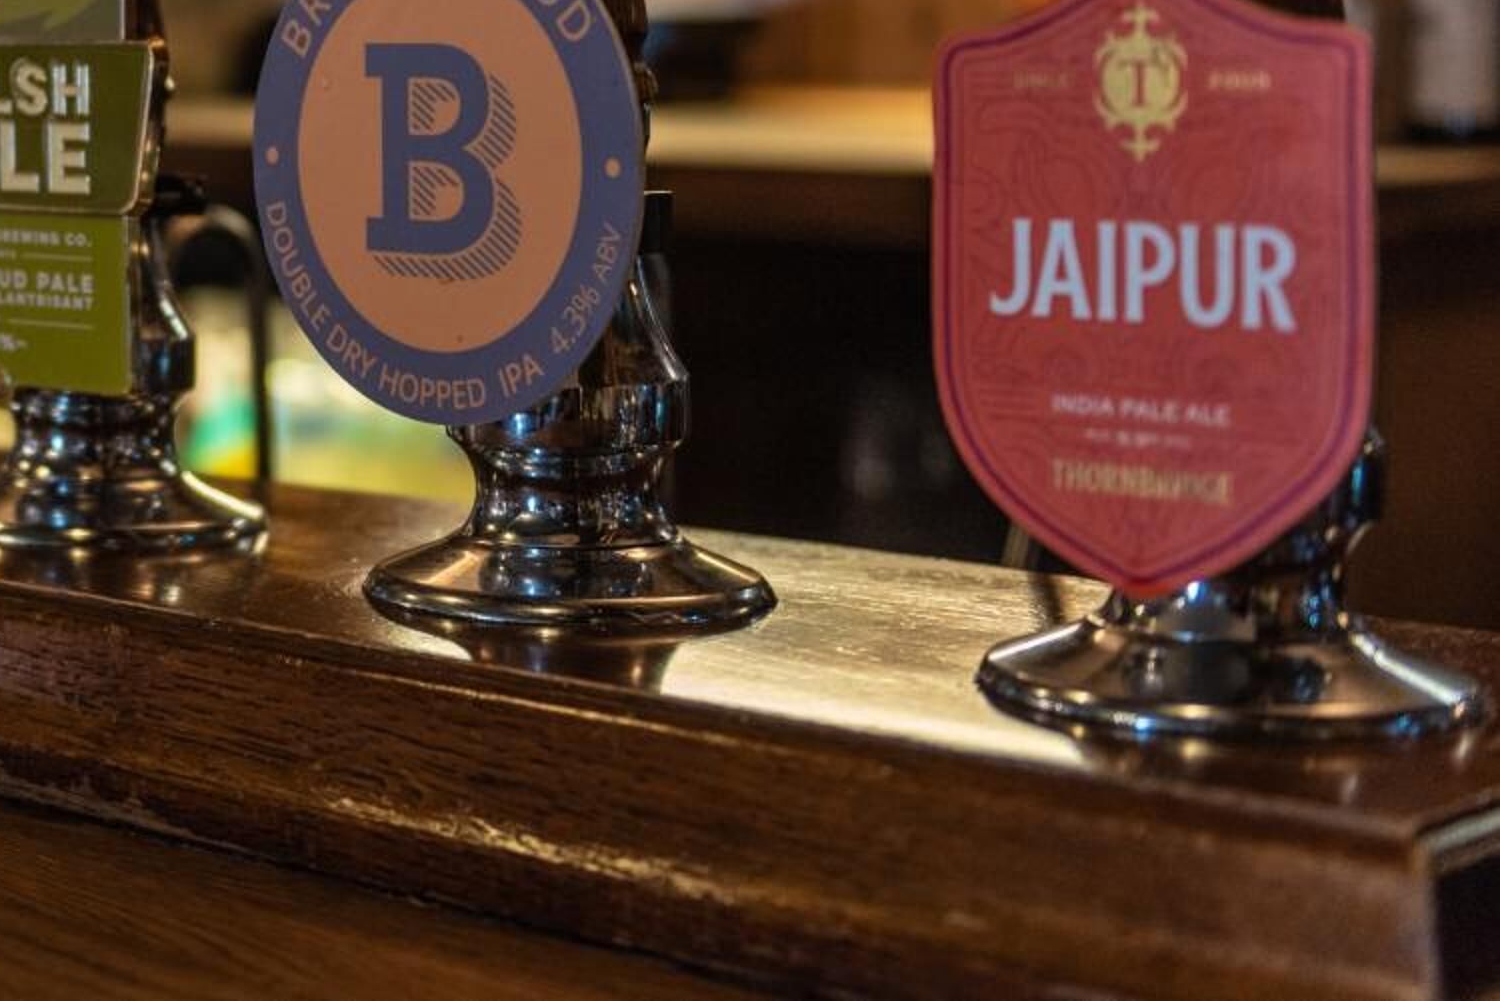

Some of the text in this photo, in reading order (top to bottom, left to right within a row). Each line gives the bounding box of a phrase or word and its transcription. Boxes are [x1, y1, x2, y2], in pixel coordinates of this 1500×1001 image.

[365, 43, 521, 280] B
[35, 270, 94, 295] PALE
[265, 201, 622, 410] DOUBLE DRY HOPPED IPA 4.3% ABV
[989, 216, 1297, 334] JAIPUR
[1052, 393, 1231, 429] INDIA PALE ALE
